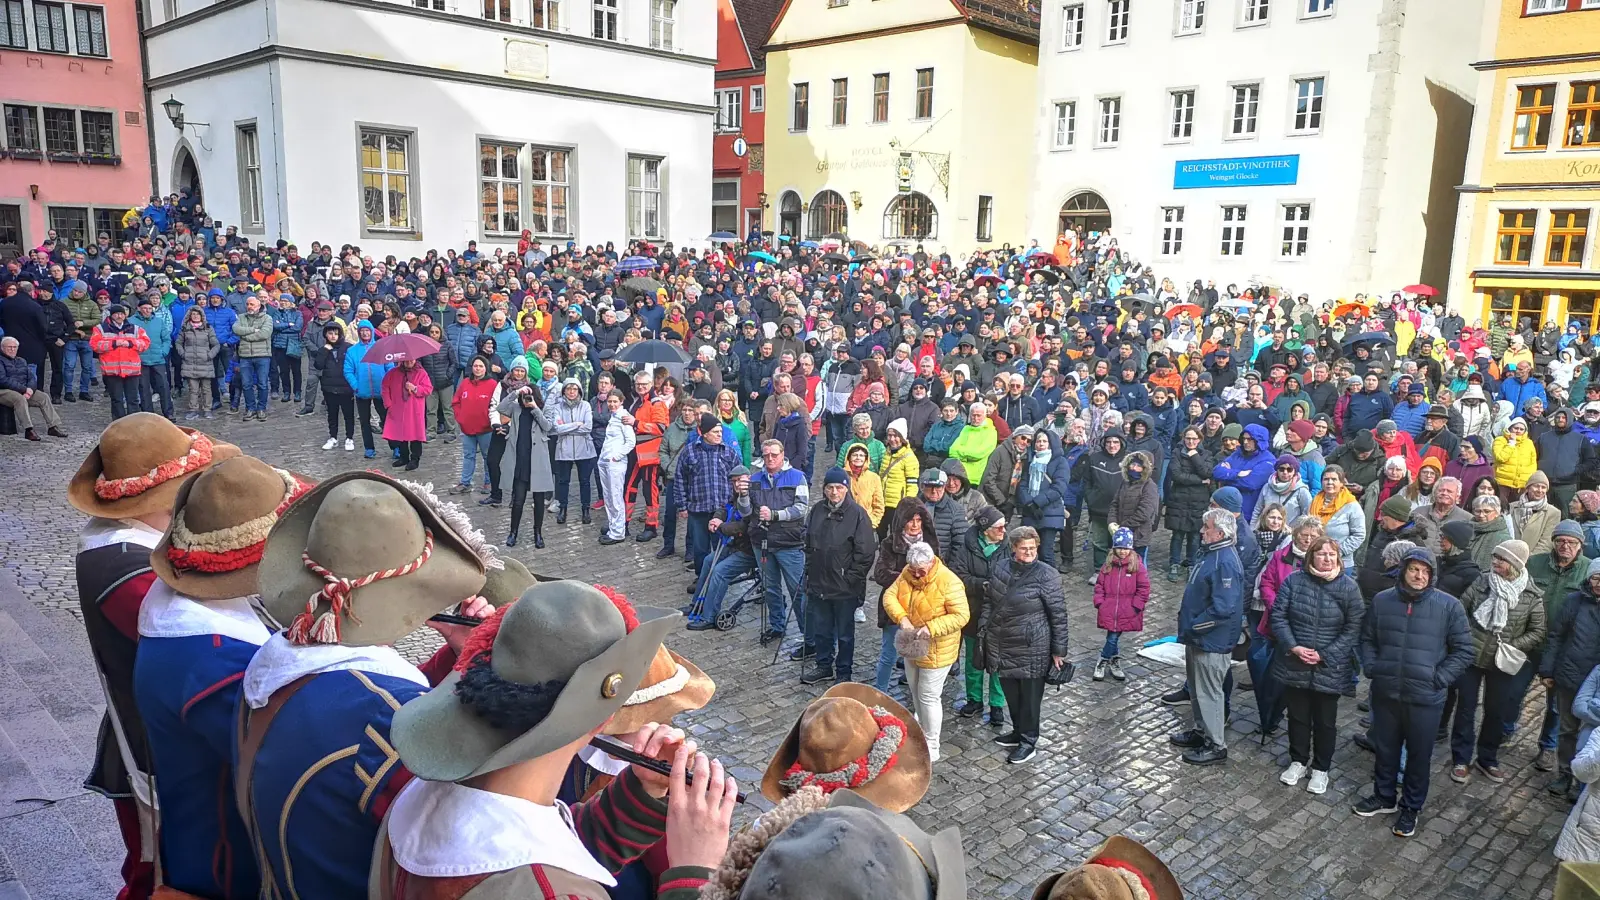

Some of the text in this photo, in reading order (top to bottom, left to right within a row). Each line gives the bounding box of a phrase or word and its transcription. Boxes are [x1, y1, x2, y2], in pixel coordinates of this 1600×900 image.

[1182, 160, 1291, 172] REICHSSTADT-VINOTHEK
[1209, 172, 1259, 182] Weingut Glocke
